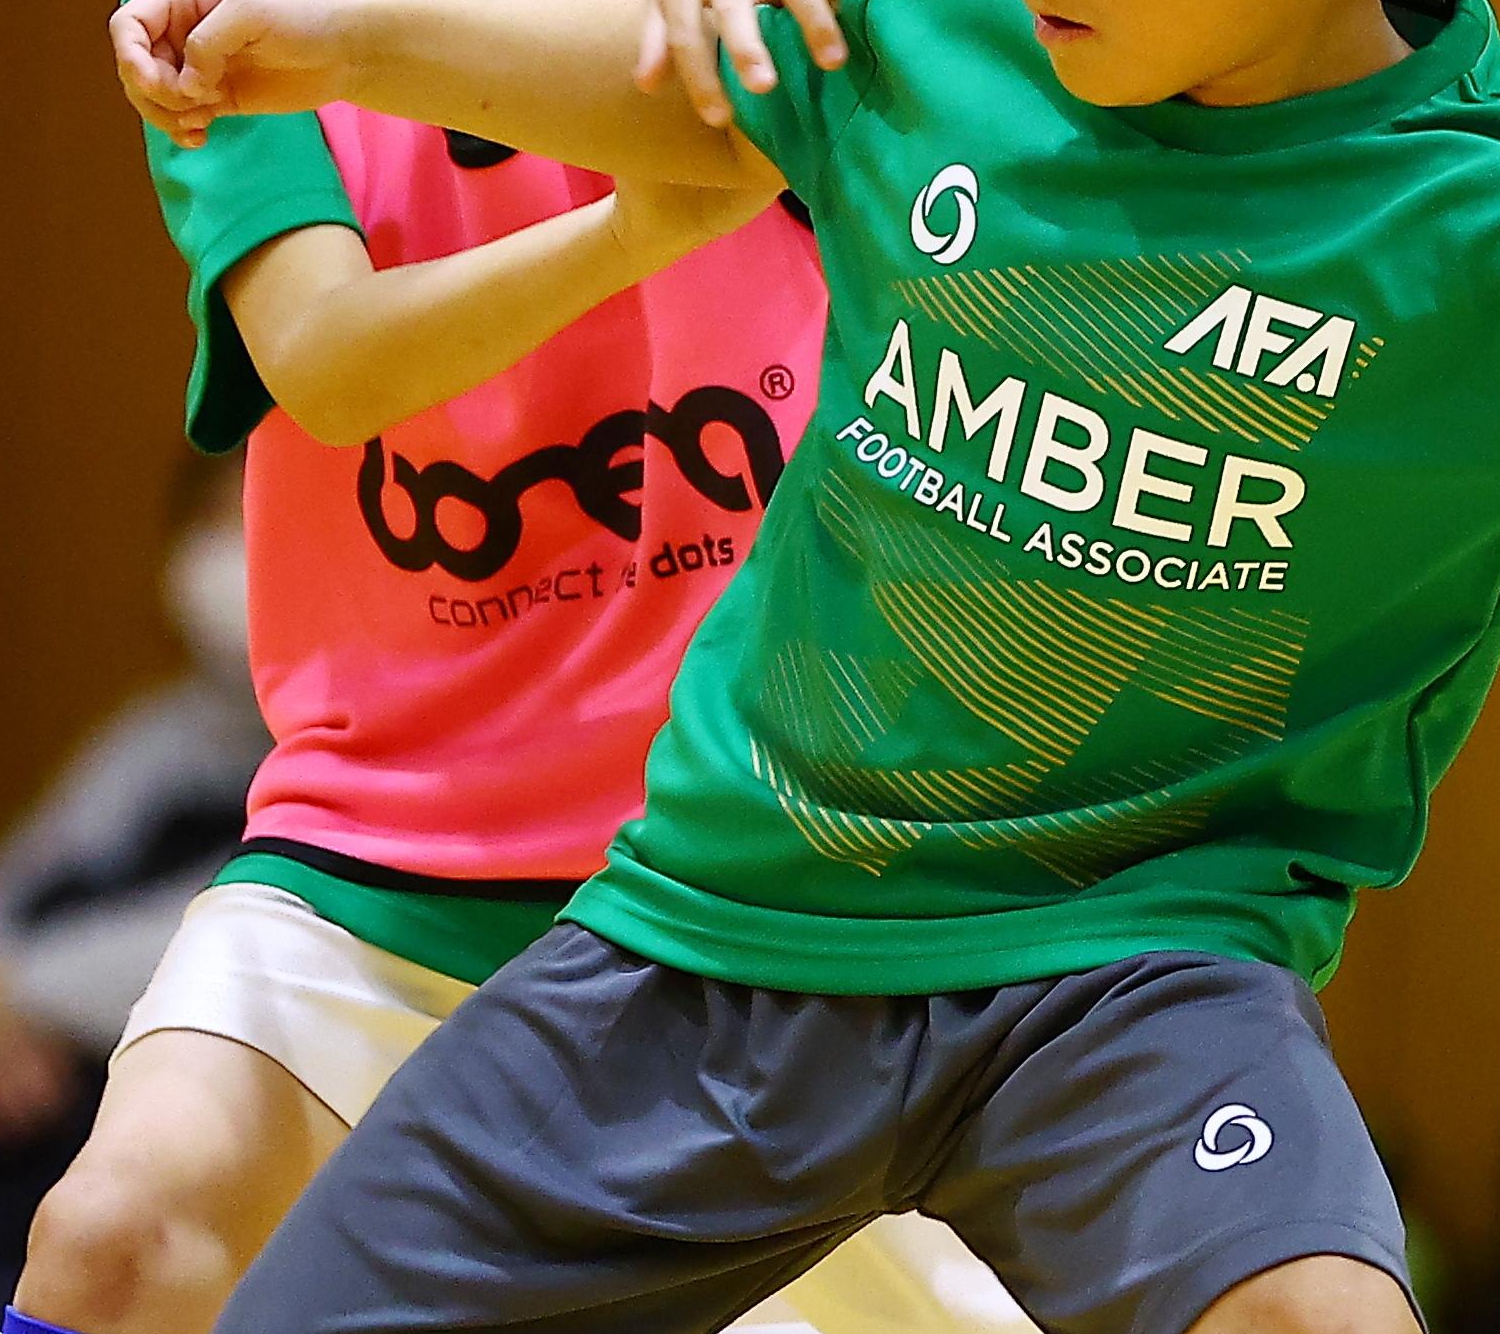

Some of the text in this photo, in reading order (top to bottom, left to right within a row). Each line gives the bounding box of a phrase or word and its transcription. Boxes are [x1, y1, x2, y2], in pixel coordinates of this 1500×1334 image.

[1163, 283, 1356, 398] AFA
[835, 416, 1289, 592] FOOTBALL ASSOCIATE
[864, 317, 1306, 549] AMBER
[649, 533, 735, 579] dots
